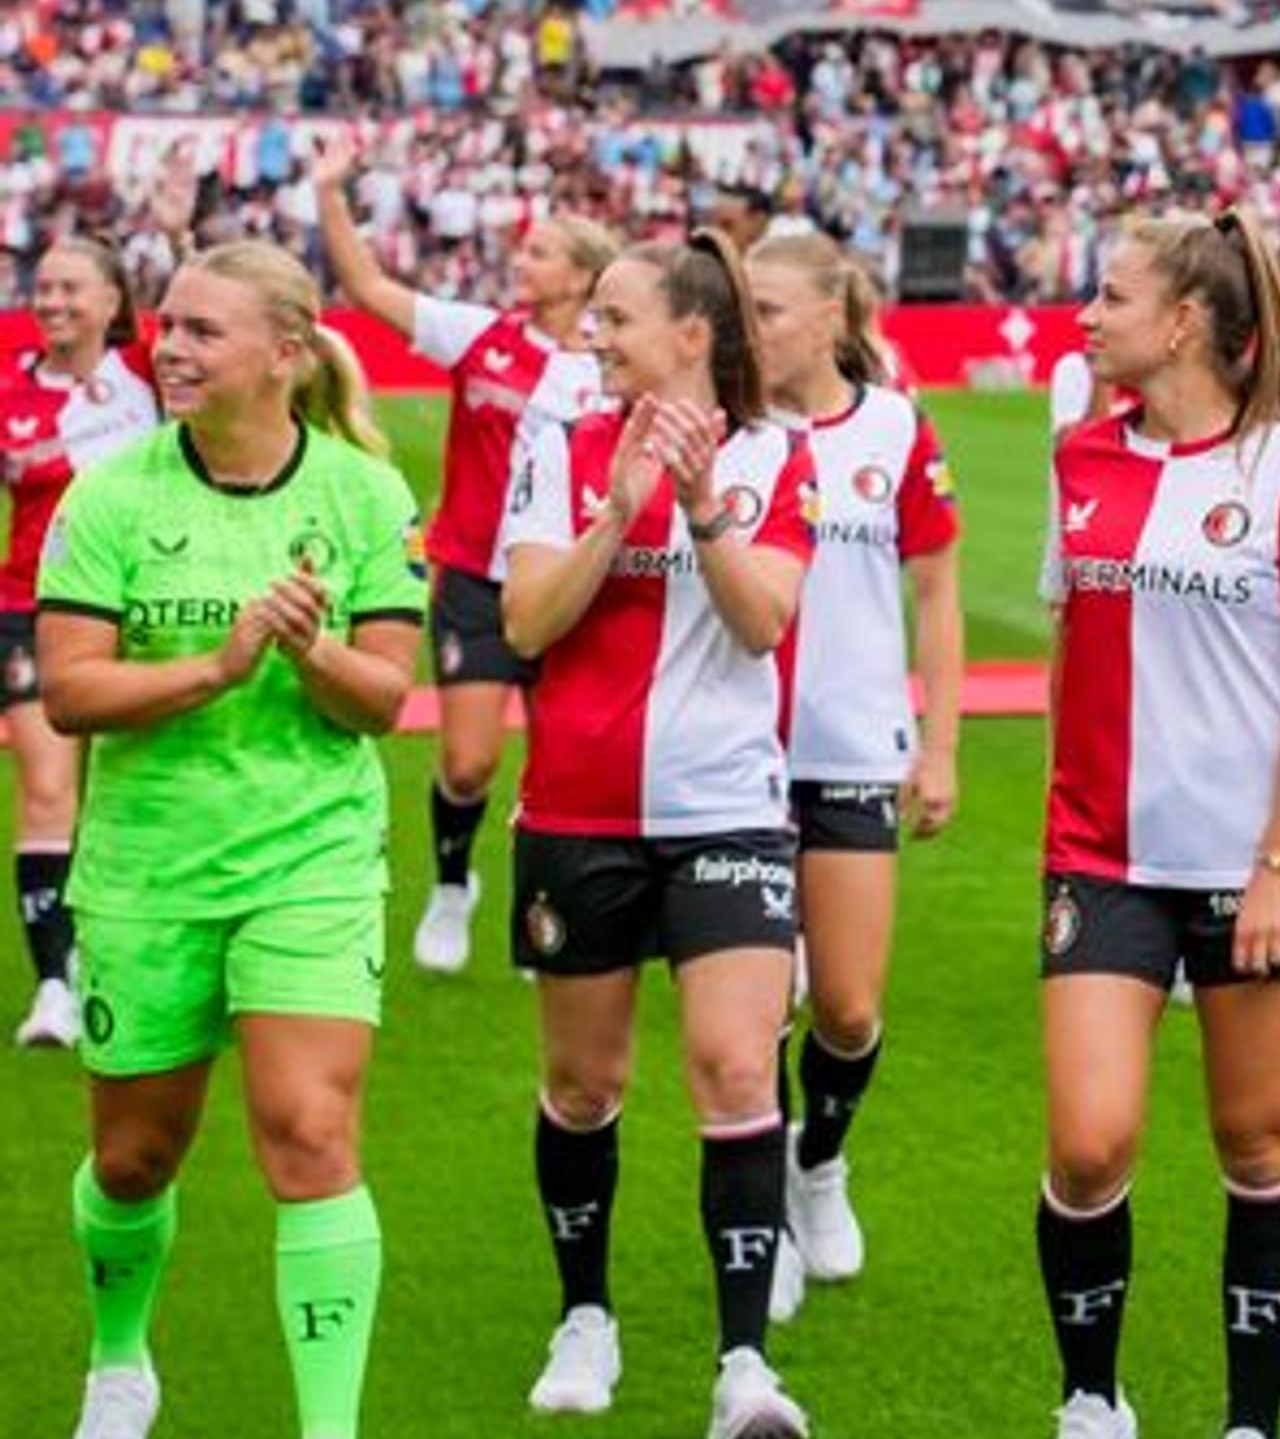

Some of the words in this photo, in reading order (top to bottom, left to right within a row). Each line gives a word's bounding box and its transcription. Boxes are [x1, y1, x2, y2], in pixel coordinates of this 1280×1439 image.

[551, 1201, 599, 1240] F
[723, 1227, 774, 1272] F
[296, 1297, 355, 1342] F
[1060, 1279, 1126, 1323] F
